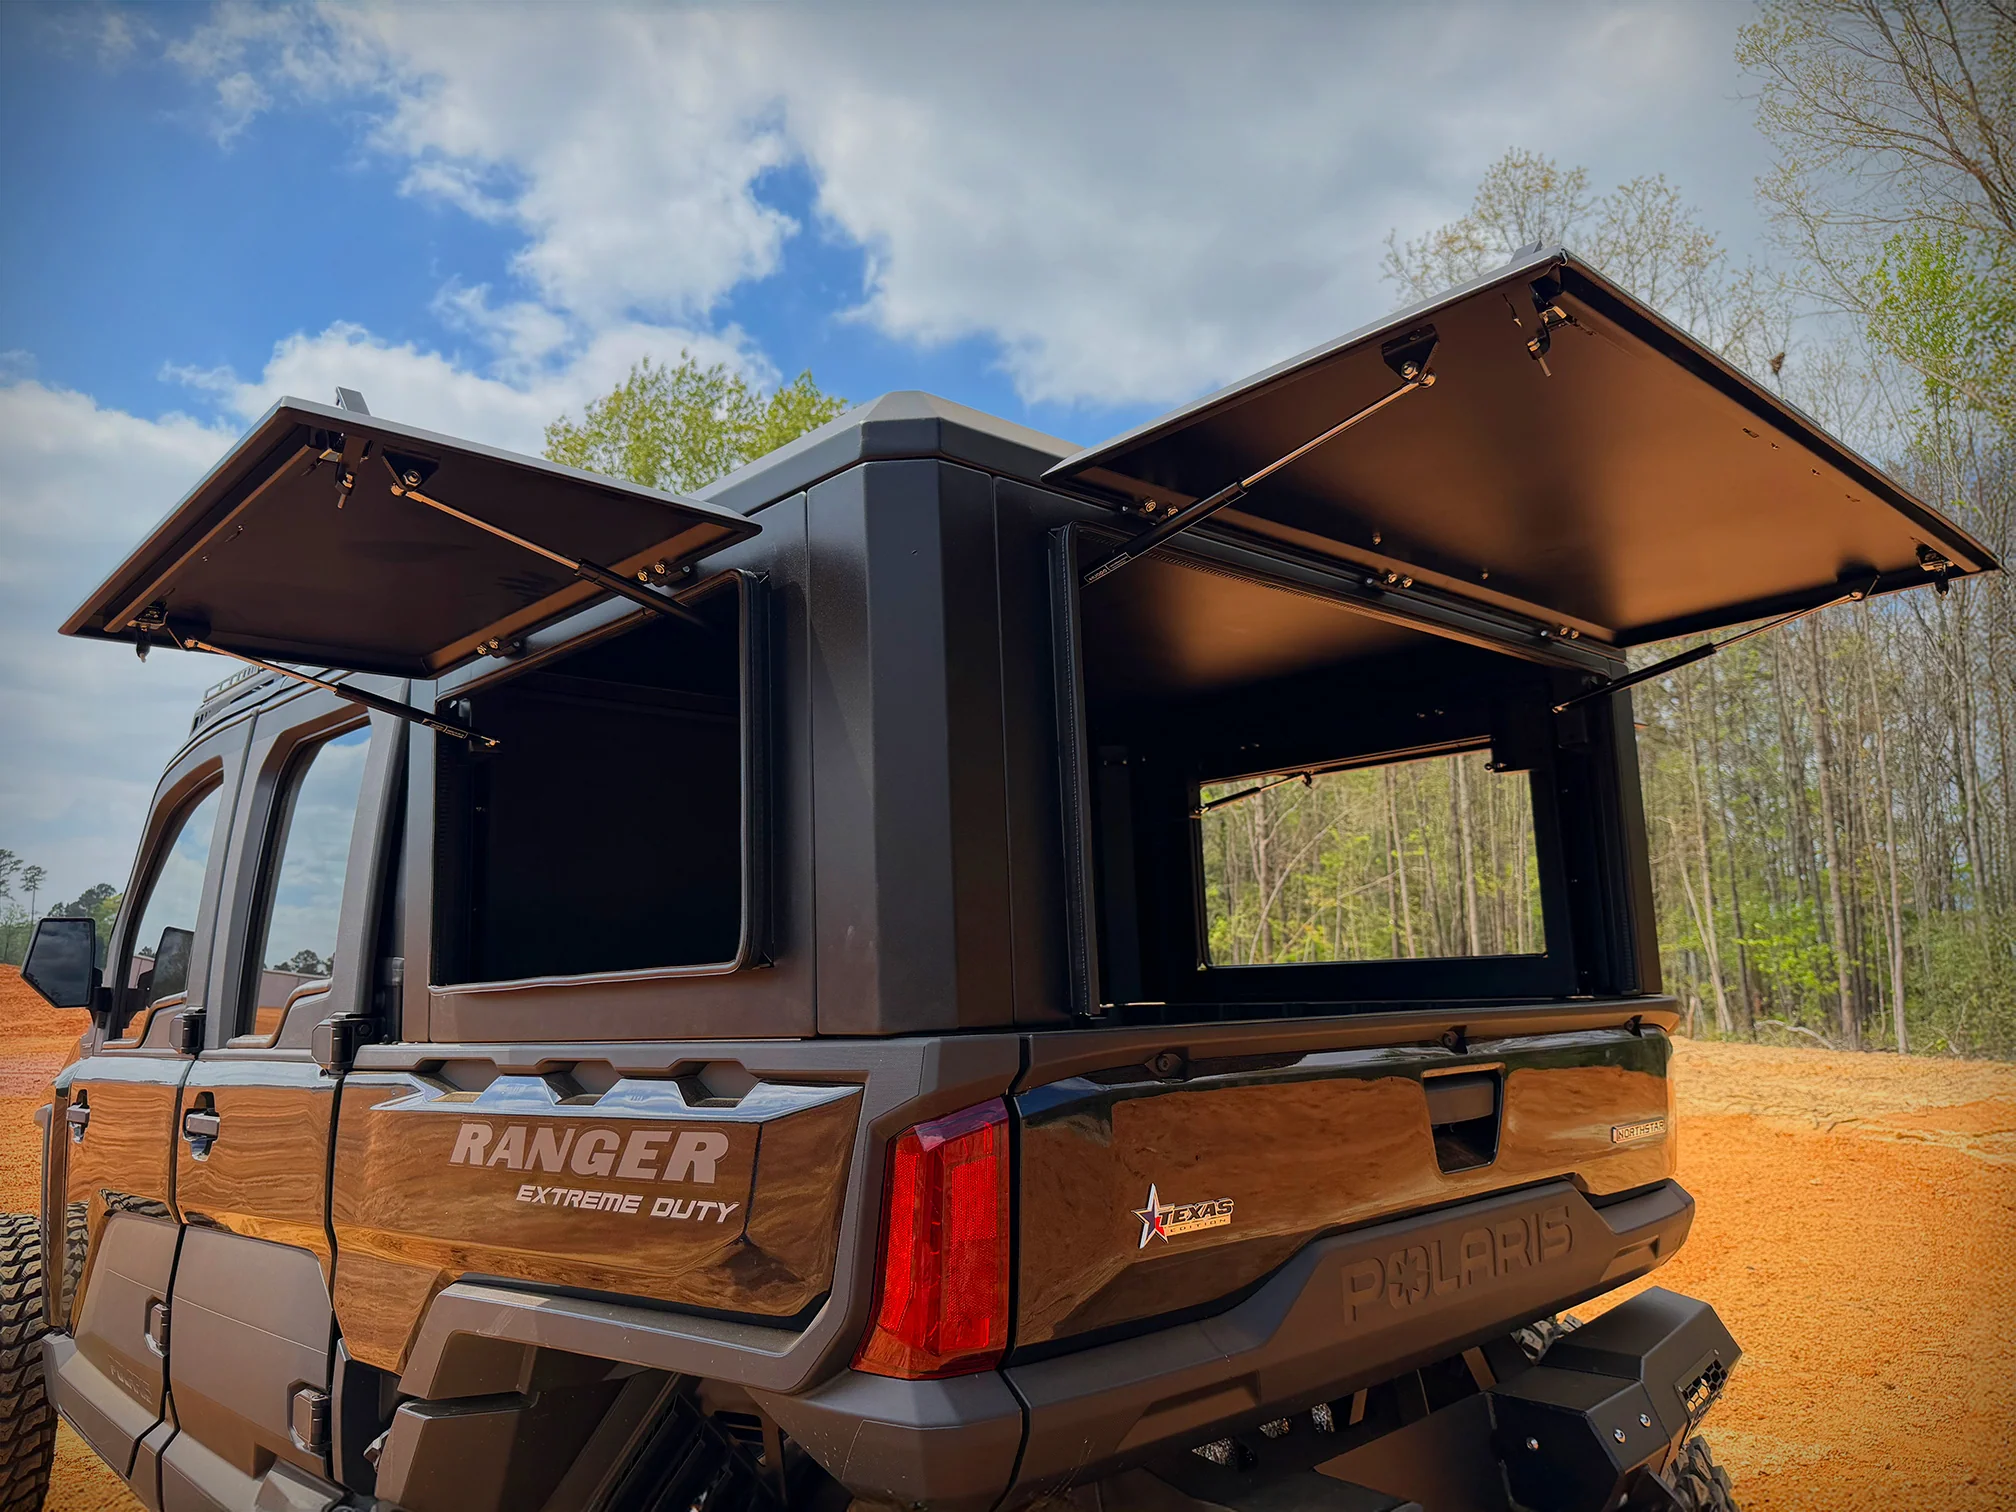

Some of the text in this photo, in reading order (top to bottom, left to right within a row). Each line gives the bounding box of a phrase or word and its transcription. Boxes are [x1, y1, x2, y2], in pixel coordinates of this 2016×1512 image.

[1618, 1121, 1664, 1139] NORTHSTAR
[449, 1122, 730, 1184] RANGER
[516, 1184, 740, 1223] EXTREME DUTY
[1159, 1199, 1233, 1226] TEXAS
[1341, 1205, 1573, 1326] POLARIS
